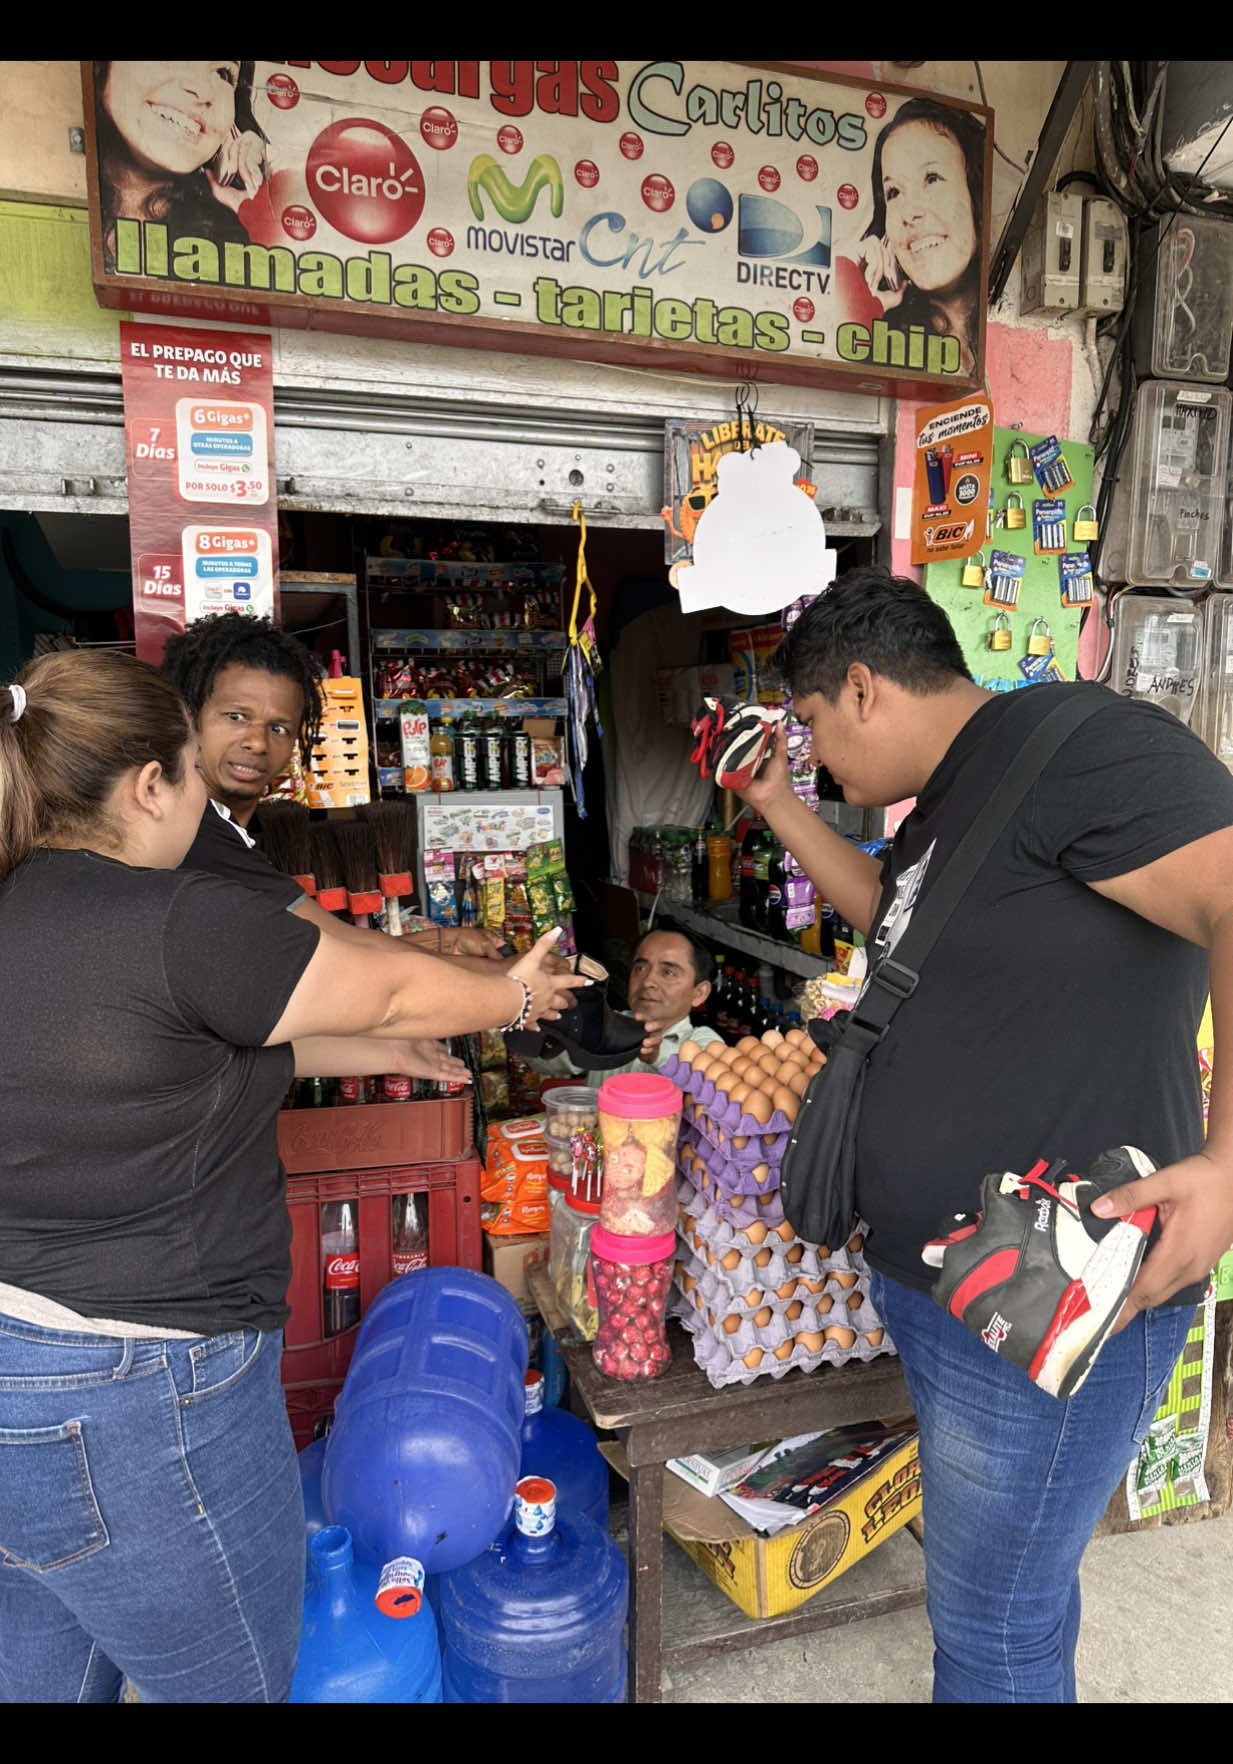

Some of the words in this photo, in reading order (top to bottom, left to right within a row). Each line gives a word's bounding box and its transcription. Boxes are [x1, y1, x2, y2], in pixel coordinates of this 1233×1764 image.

[628, 61, 867, 151] Carlitos
[422, 122, 456, 136] Claro
[315, 164, 410, 200] Claro
[643, 186, 673, 199] Claro
[283, 215, 313, 229] Claro
[736, 262, 830, 295] DIRECTV
[115, 218, 480, 315] llamadas
[533, 277, 790, 353] tarjetas
[836, 320, 960, 374] chip
[131, 343, 150, 358] EL
[153, 345, 227, 364] PREPAGO
[230, 353, 262, 368] QUE
[154, 364, 173, 380] TE
[177, 366, 199, 381] DA
[203, 365, 241, 384] MÁS
[194, 408, 205, 424] 6
[928, 406, 982, 430] ENCIENDE
[150, 428, 160, 442] 7
[918, 432, 934, 447] tus
[938, 414, 988, 440] momentos
[136, 443, 175, 460] Días
[186, 481, 204, 490] POR
[206, 483, 228, 491] SOLO
[199, 534, 211, 550] 8
[936, 526, 965, 541] BIC
[153, 565, 171, 580] 15
[143, 580, 182, 596] Días
[463, 737, 478, 783] AMPER
[487, 737, 501, 783] AMPER
[515, 736, 529, 782] AMPER
